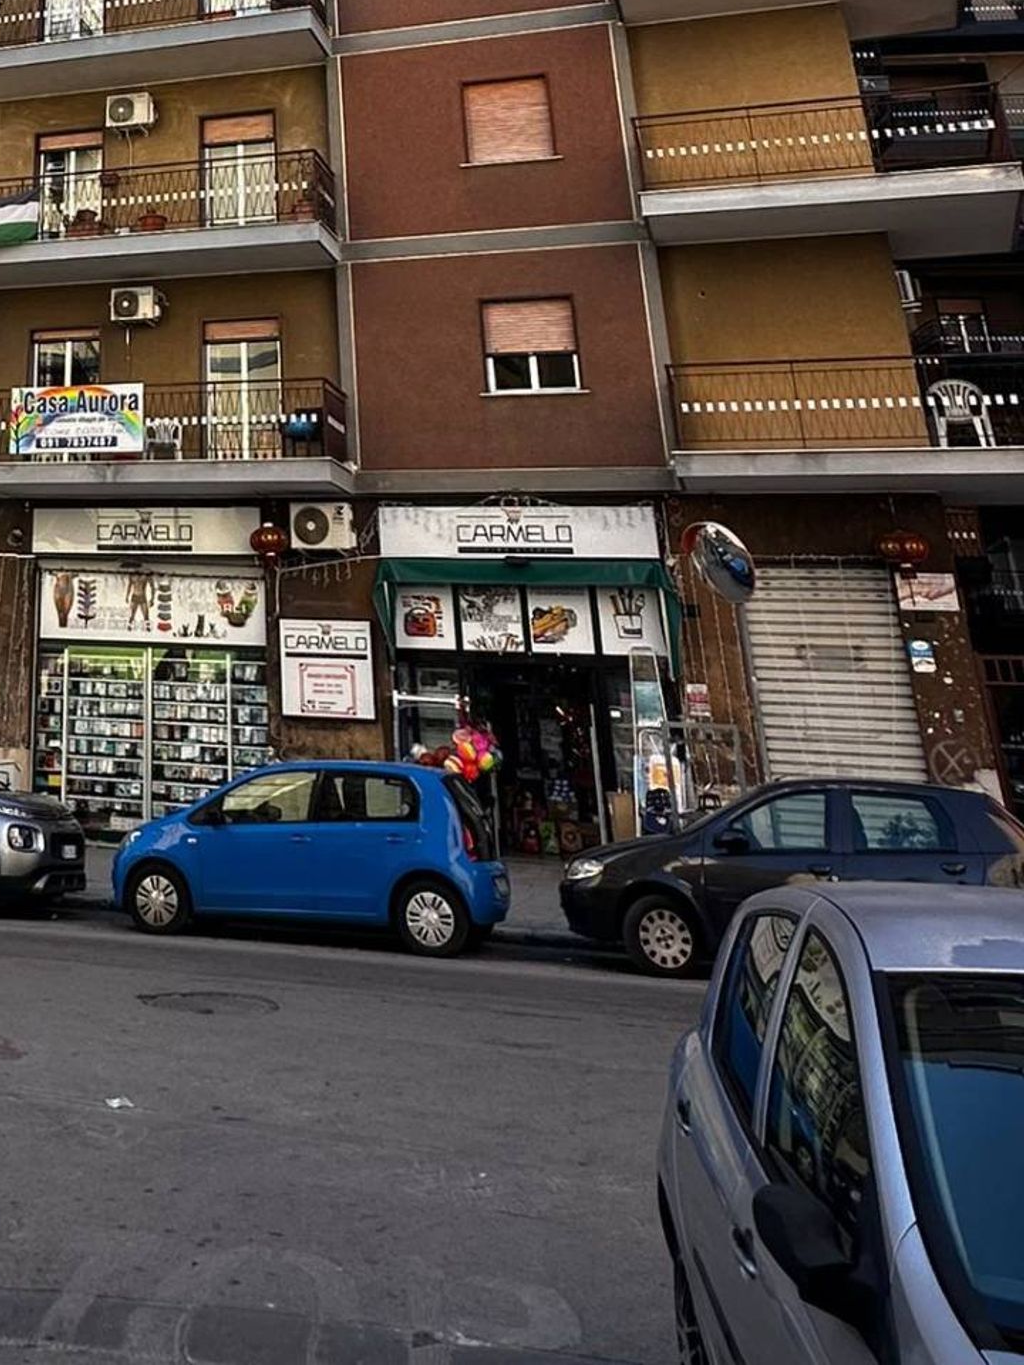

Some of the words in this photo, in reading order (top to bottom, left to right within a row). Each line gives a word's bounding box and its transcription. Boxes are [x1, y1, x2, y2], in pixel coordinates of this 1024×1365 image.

[24, 391, 68, 414] Casa
[76, 390, 139, 413] Aurora
[96, 524, 193, 542] CARMELO
[456, 524, 573, 544] CARMELO
[284, 635, 368, 652] CARMELO
